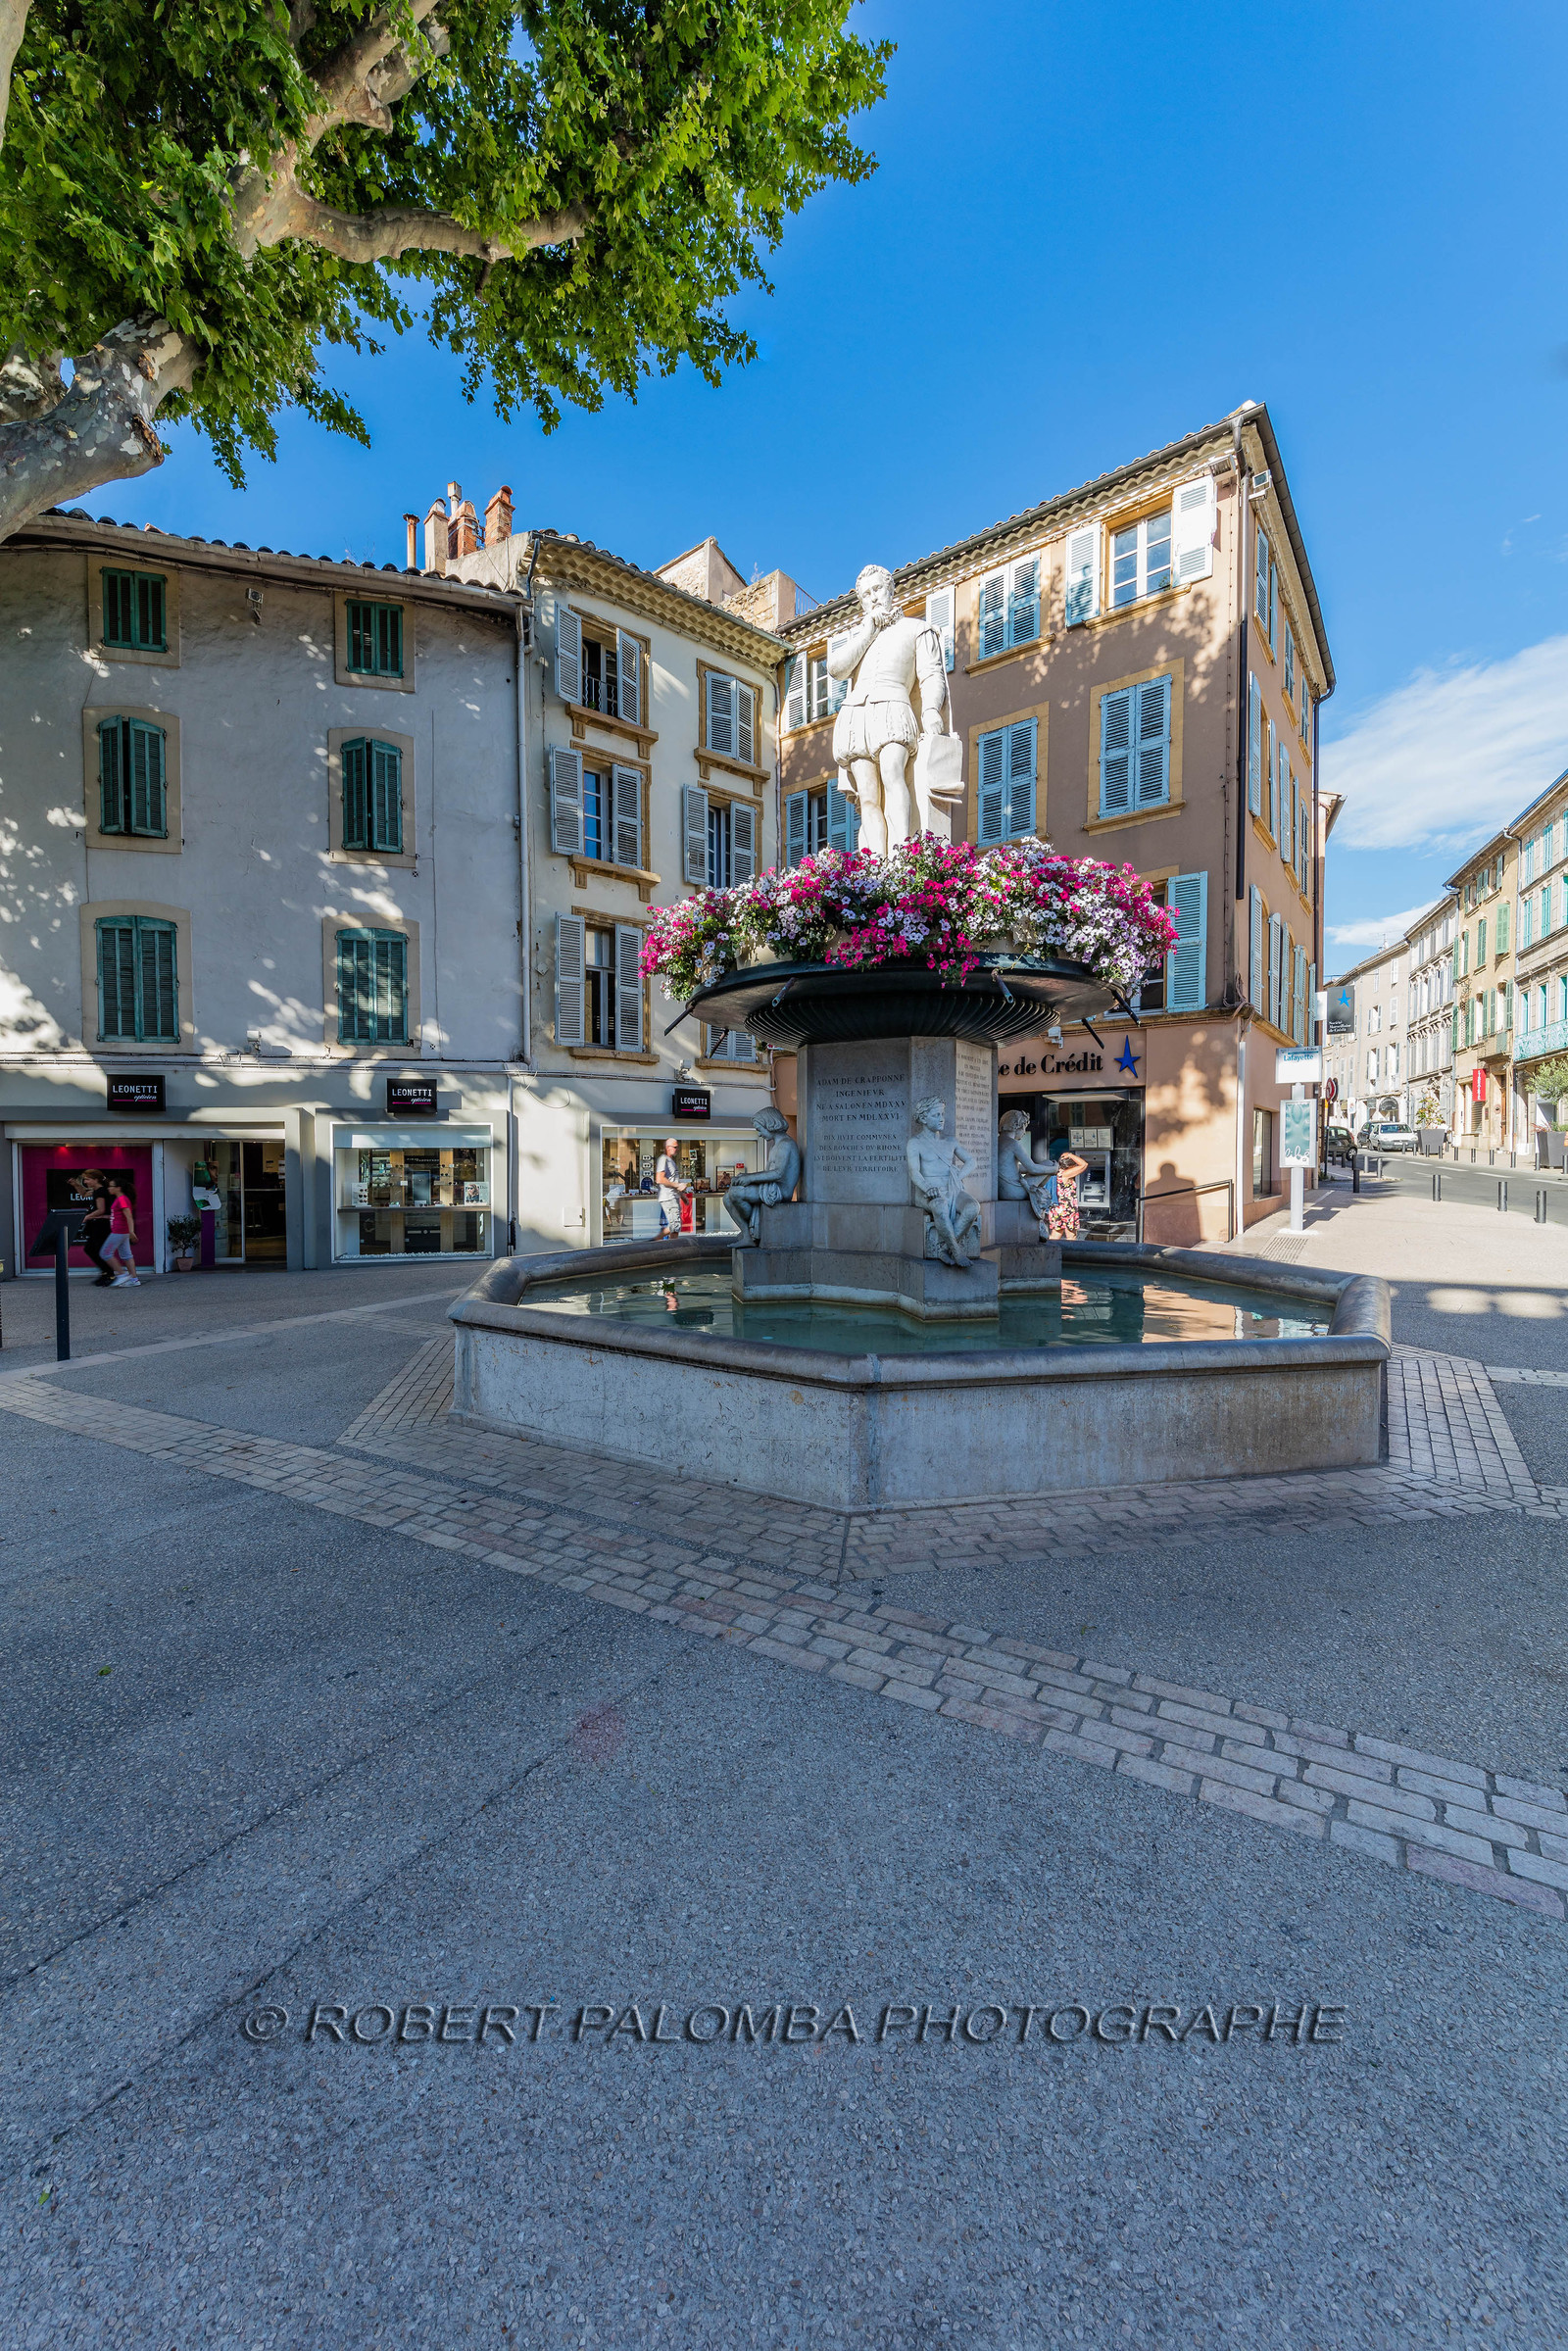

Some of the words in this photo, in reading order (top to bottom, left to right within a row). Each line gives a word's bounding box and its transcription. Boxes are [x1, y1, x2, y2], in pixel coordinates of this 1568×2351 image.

[1283, 1053, 1314, 1062] Lafayette
[998, 1063, 1010, 1076] e
[1014, 1056, 1037, 1075] de
[1041, 1052, 1103, 1074] Crédit
[855, 1074, 906, 1084] CRAPPONNE
[112, 1085, 158, 1094] LEONETTI
[836, 1089, 885, 1098] INGENIEVR
[133, 1094, 157, 1102] opticien
[680, 1097, 708, 1105] LEONETTI
